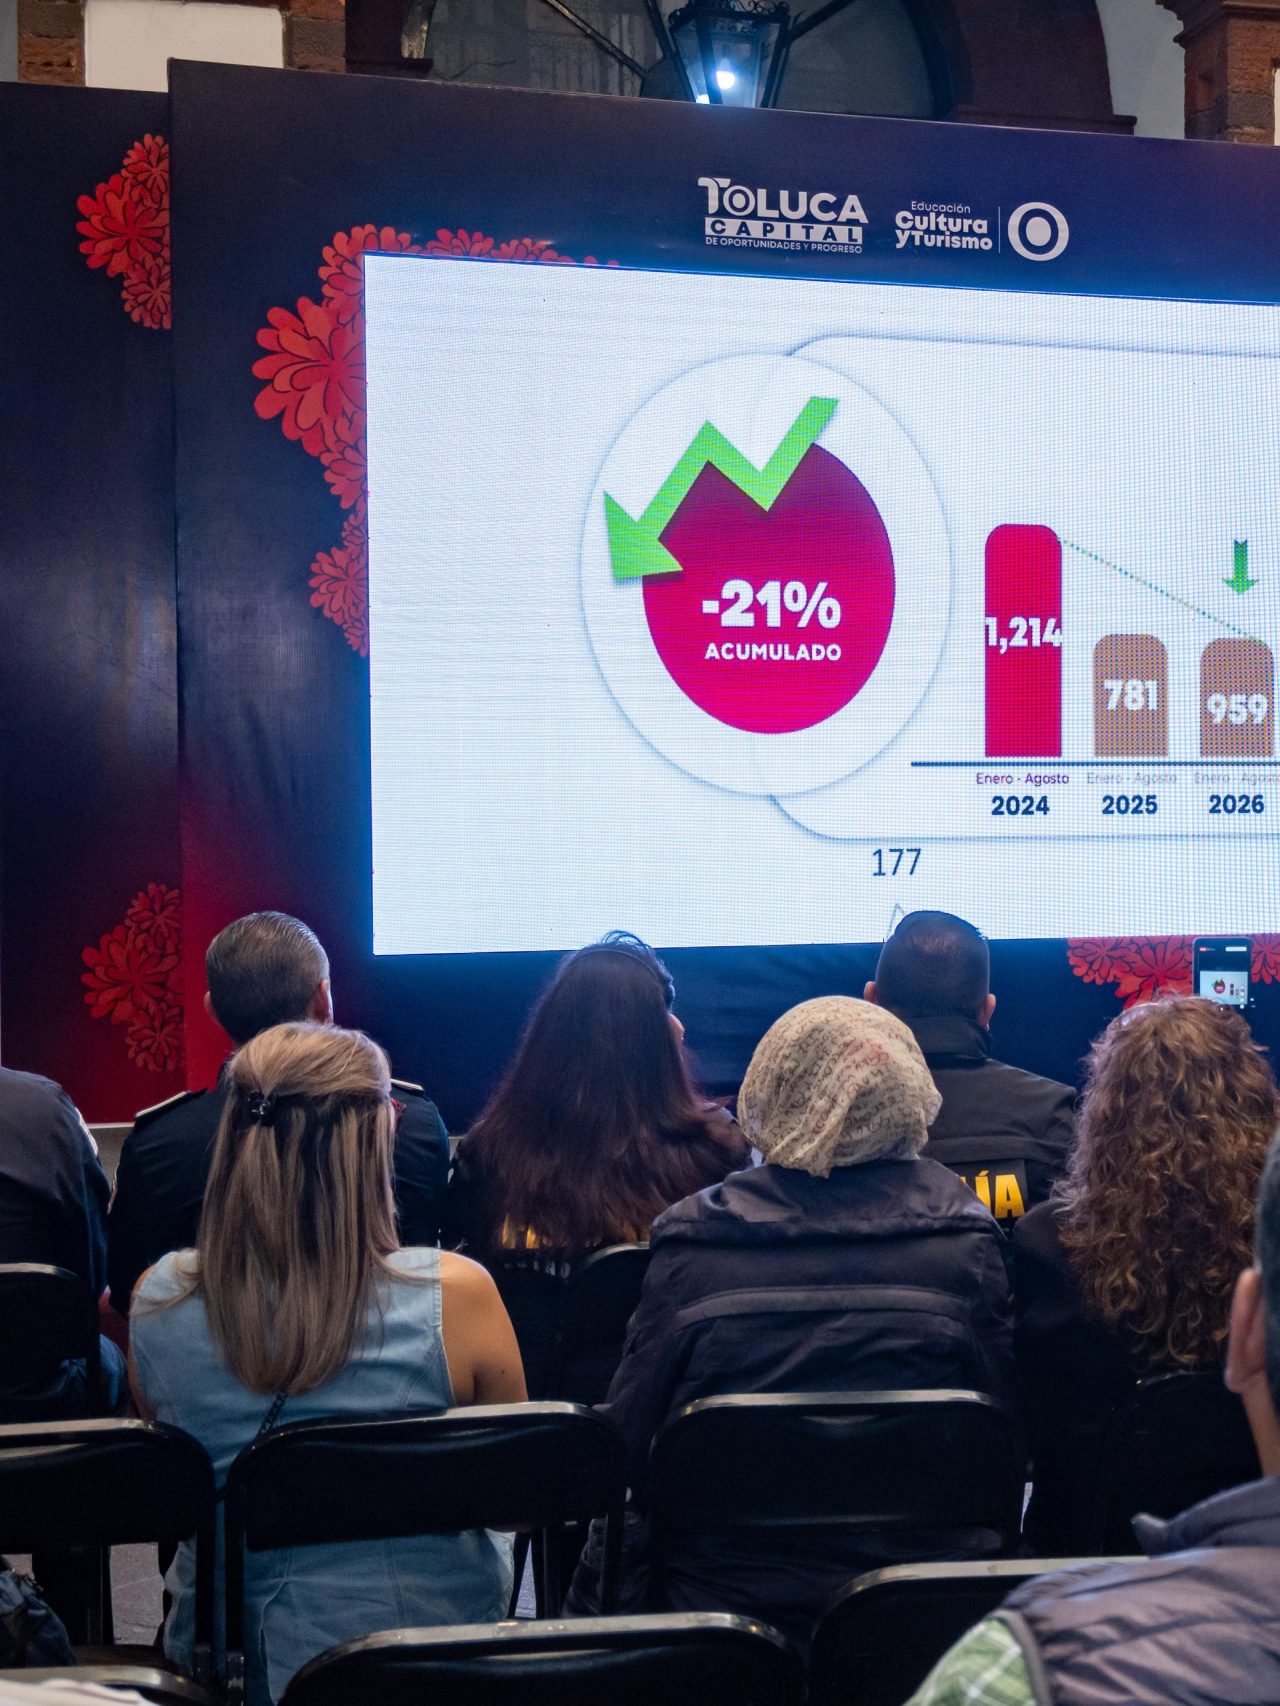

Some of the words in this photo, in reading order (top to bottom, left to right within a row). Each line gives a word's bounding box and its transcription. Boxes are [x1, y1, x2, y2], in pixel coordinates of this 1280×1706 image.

[698, 177, 868, 224] TOLUCA
[911, 201, 970, 214] Educación
[709, 219, 861, 243] CAPITAL
[895, 210, 988, 234] Cultura
[705, 237, 718, 246] DE
[720, 238, 801, 251] OPORTUNIDADES
[803, 243, 809, 251] Y
[811, 243, 862, 254] PROGRESO
[702, 579, 842, 629] -21%
[985, 616, 1062, 654] 1,214
[704, 643, 842, 661] ACUMULADO
[1103, 679, 1158, 711] 781
[1207, 693, 1269, 725] 959
[976, 772, 1013, 785] Enero
[1025, 772, 1070, 787] Agosto
[991, 795, 1050, 816] 2024
[1102, 795, 1158, 815] 2025
[1208, 794, 1265, 815] 2026
[872, 847, 922, 876] 177
